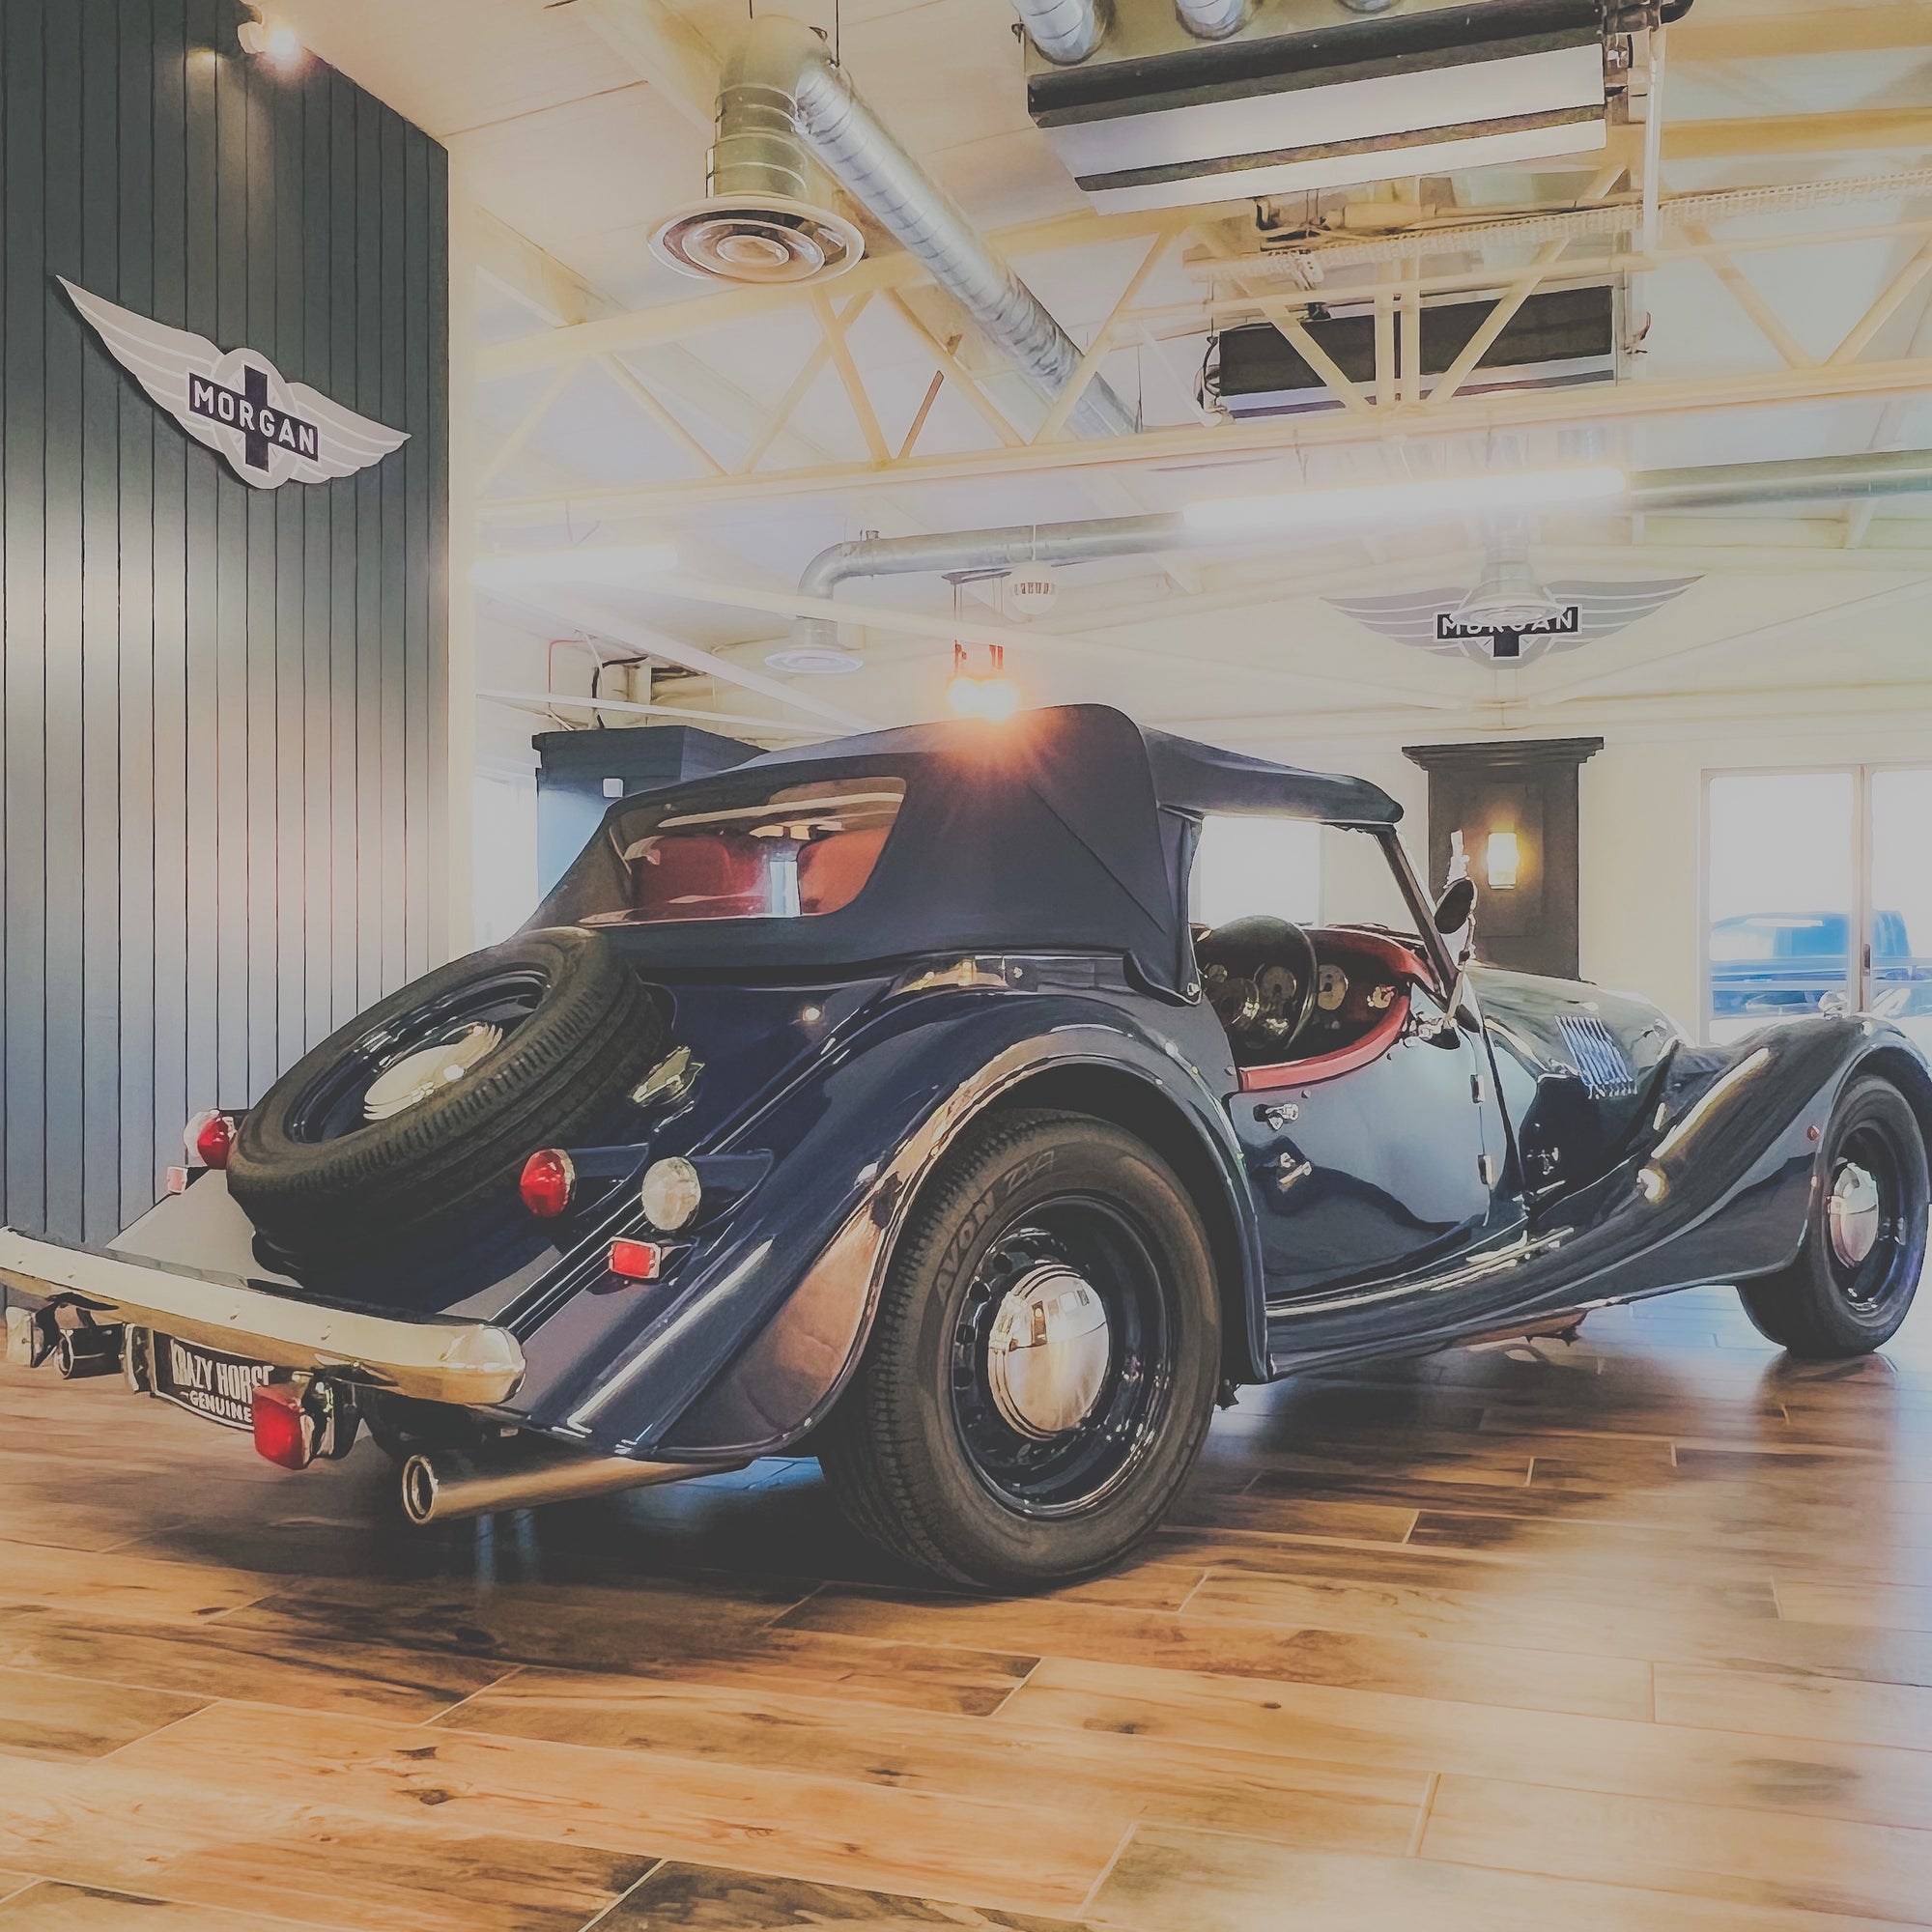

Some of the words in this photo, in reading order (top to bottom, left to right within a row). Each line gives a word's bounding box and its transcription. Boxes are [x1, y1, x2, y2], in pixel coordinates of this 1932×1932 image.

[193, 380, 315, 455] MORGAN
[936, 1189, 996, 1305] AVON
[189, 1390, 253, 1423] GENUINE
